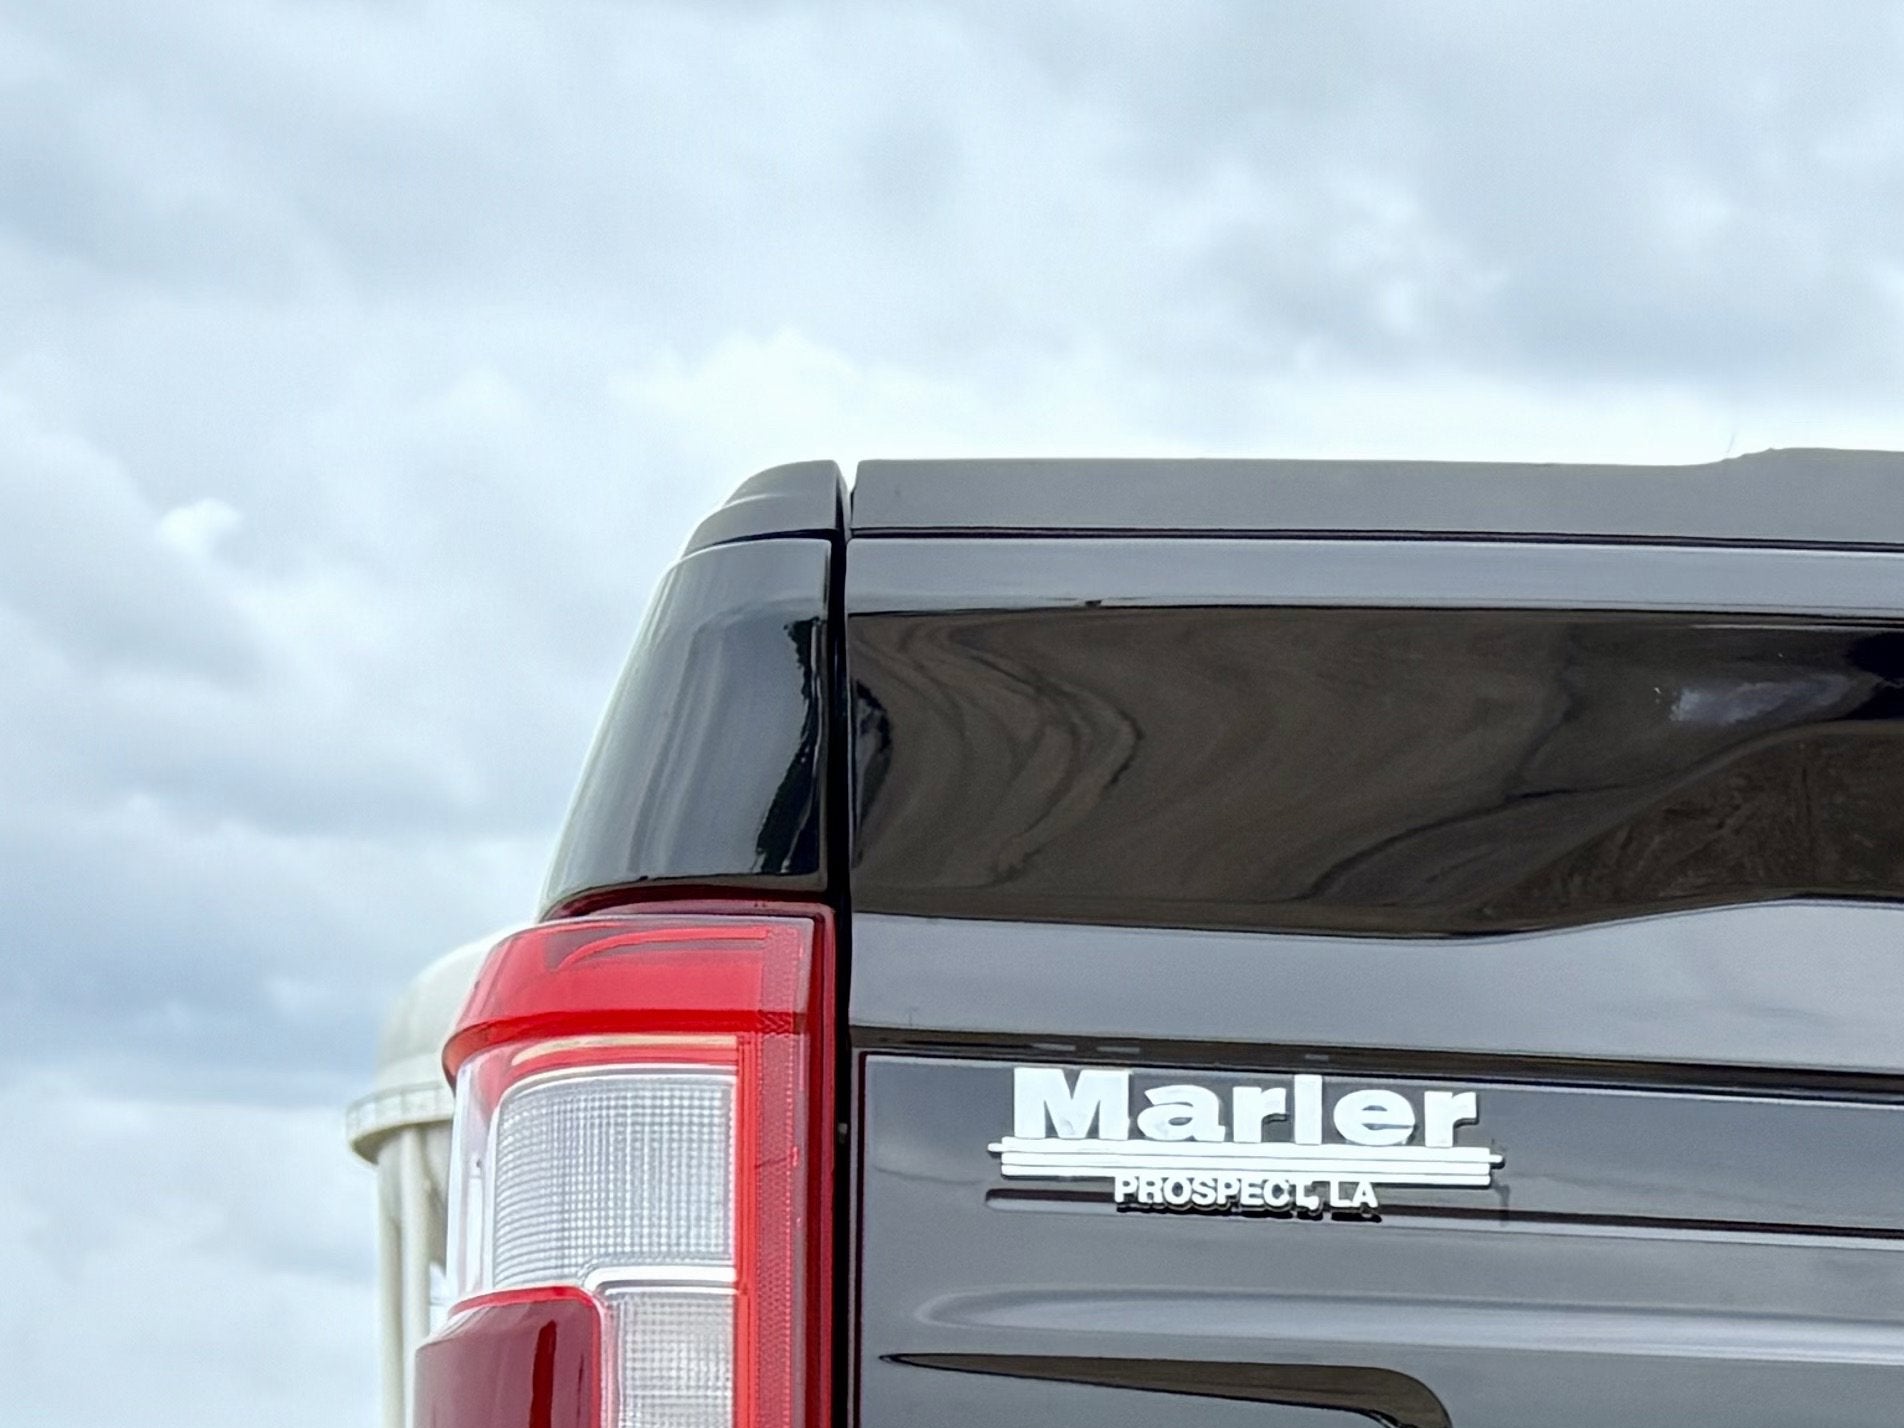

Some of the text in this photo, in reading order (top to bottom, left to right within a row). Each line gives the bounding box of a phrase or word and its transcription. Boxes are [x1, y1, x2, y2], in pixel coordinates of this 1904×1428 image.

[1013, 1066, 1477, 1148] Marler
[1114, 1176, 1379, 1209] PROSPECT, LA
